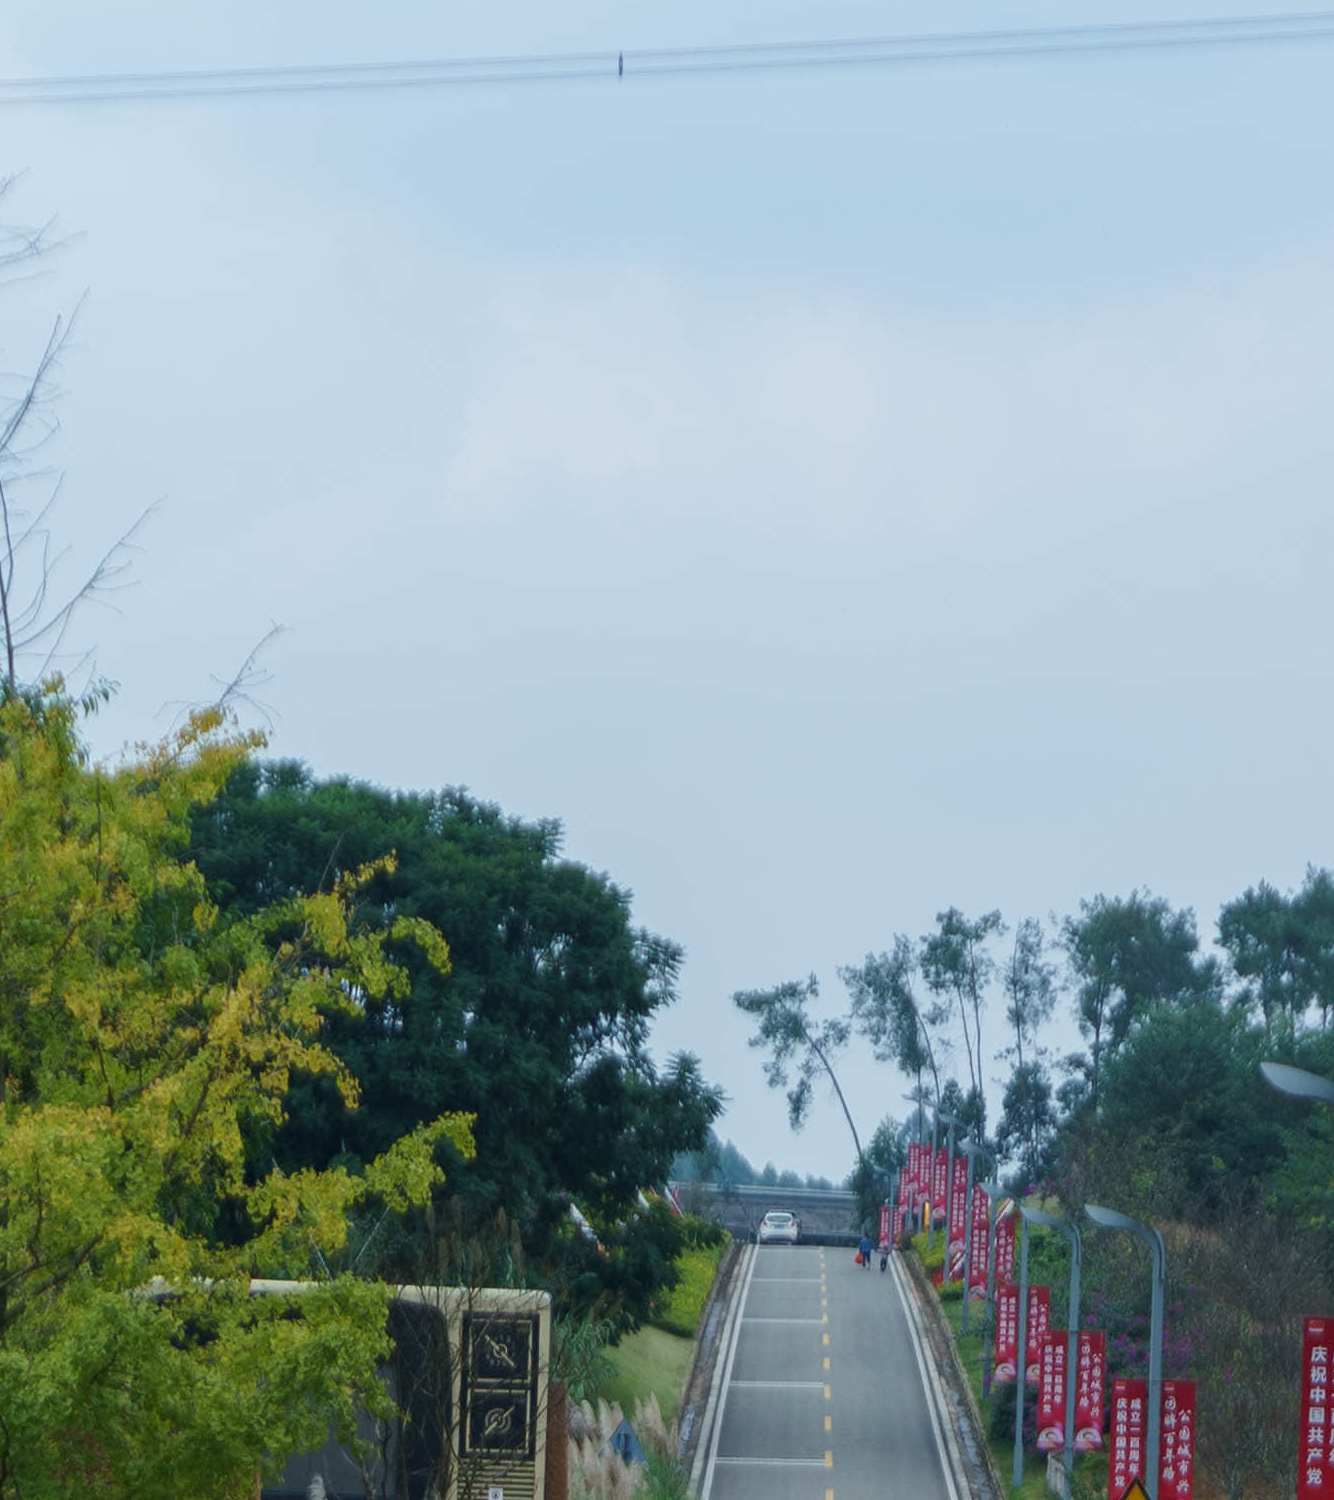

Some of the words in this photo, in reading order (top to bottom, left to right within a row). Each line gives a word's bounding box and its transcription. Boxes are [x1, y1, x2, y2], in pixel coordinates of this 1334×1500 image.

[1306, 1346, 1328, 1484] 庆祝中国共产党
